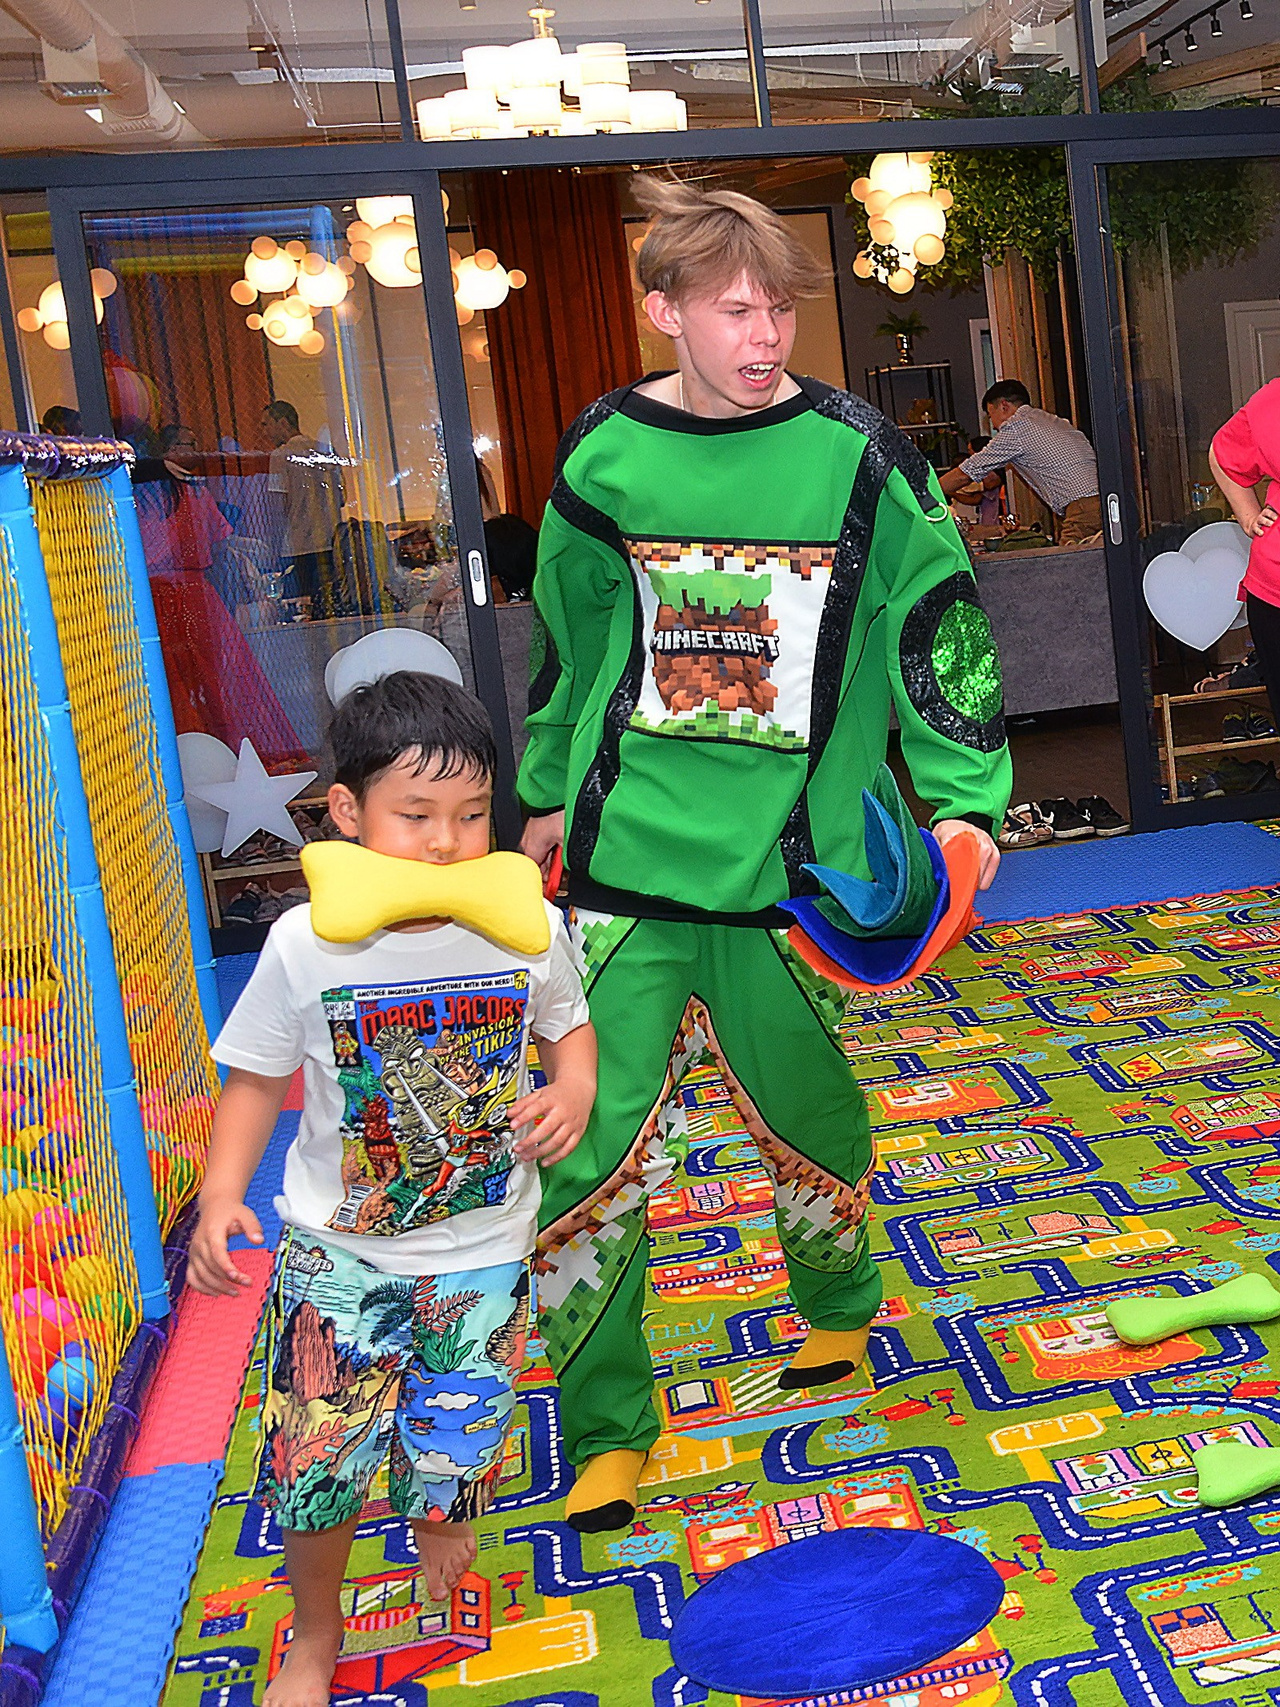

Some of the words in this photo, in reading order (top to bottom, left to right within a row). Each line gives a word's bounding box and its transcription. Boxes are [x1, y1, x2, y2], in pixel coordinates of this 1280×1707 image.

[651, 629, 780, 658] MINECRAFT
[357, 989, 386, 998] ANOTHER
[388, 986, 424, 996] INCREDIBLE
[426, 981, 462, 992] ADVENTURE
[464, 980, 480, 989] WITH
[481, 979, 494, 987] OUR
[361, 999, 435, 1045] MARC
[441, 995, 526, 1026] JACOBS
